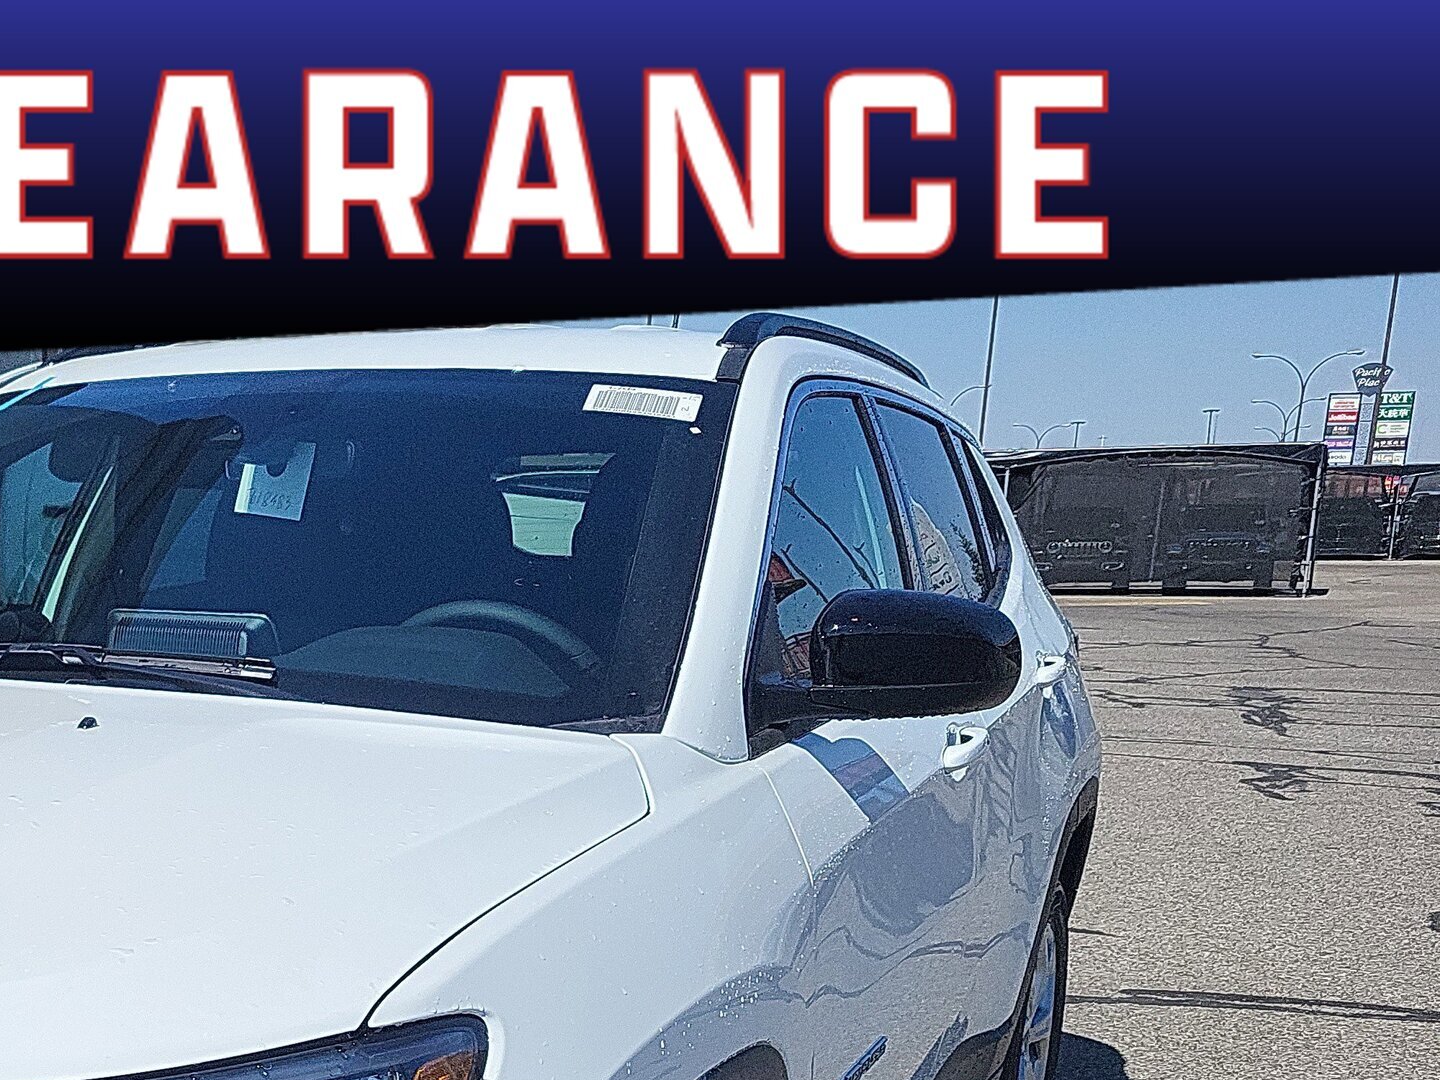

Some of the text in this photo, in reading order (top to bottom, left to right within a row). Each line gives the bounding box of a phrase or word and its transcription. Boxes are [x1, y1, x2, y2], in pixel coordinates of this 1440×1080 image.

[1355, 367, 1390, 377] Pacifc
[1357, 378, 1385, 387] Plac
[1381, 393, 1413, 404] T&T
